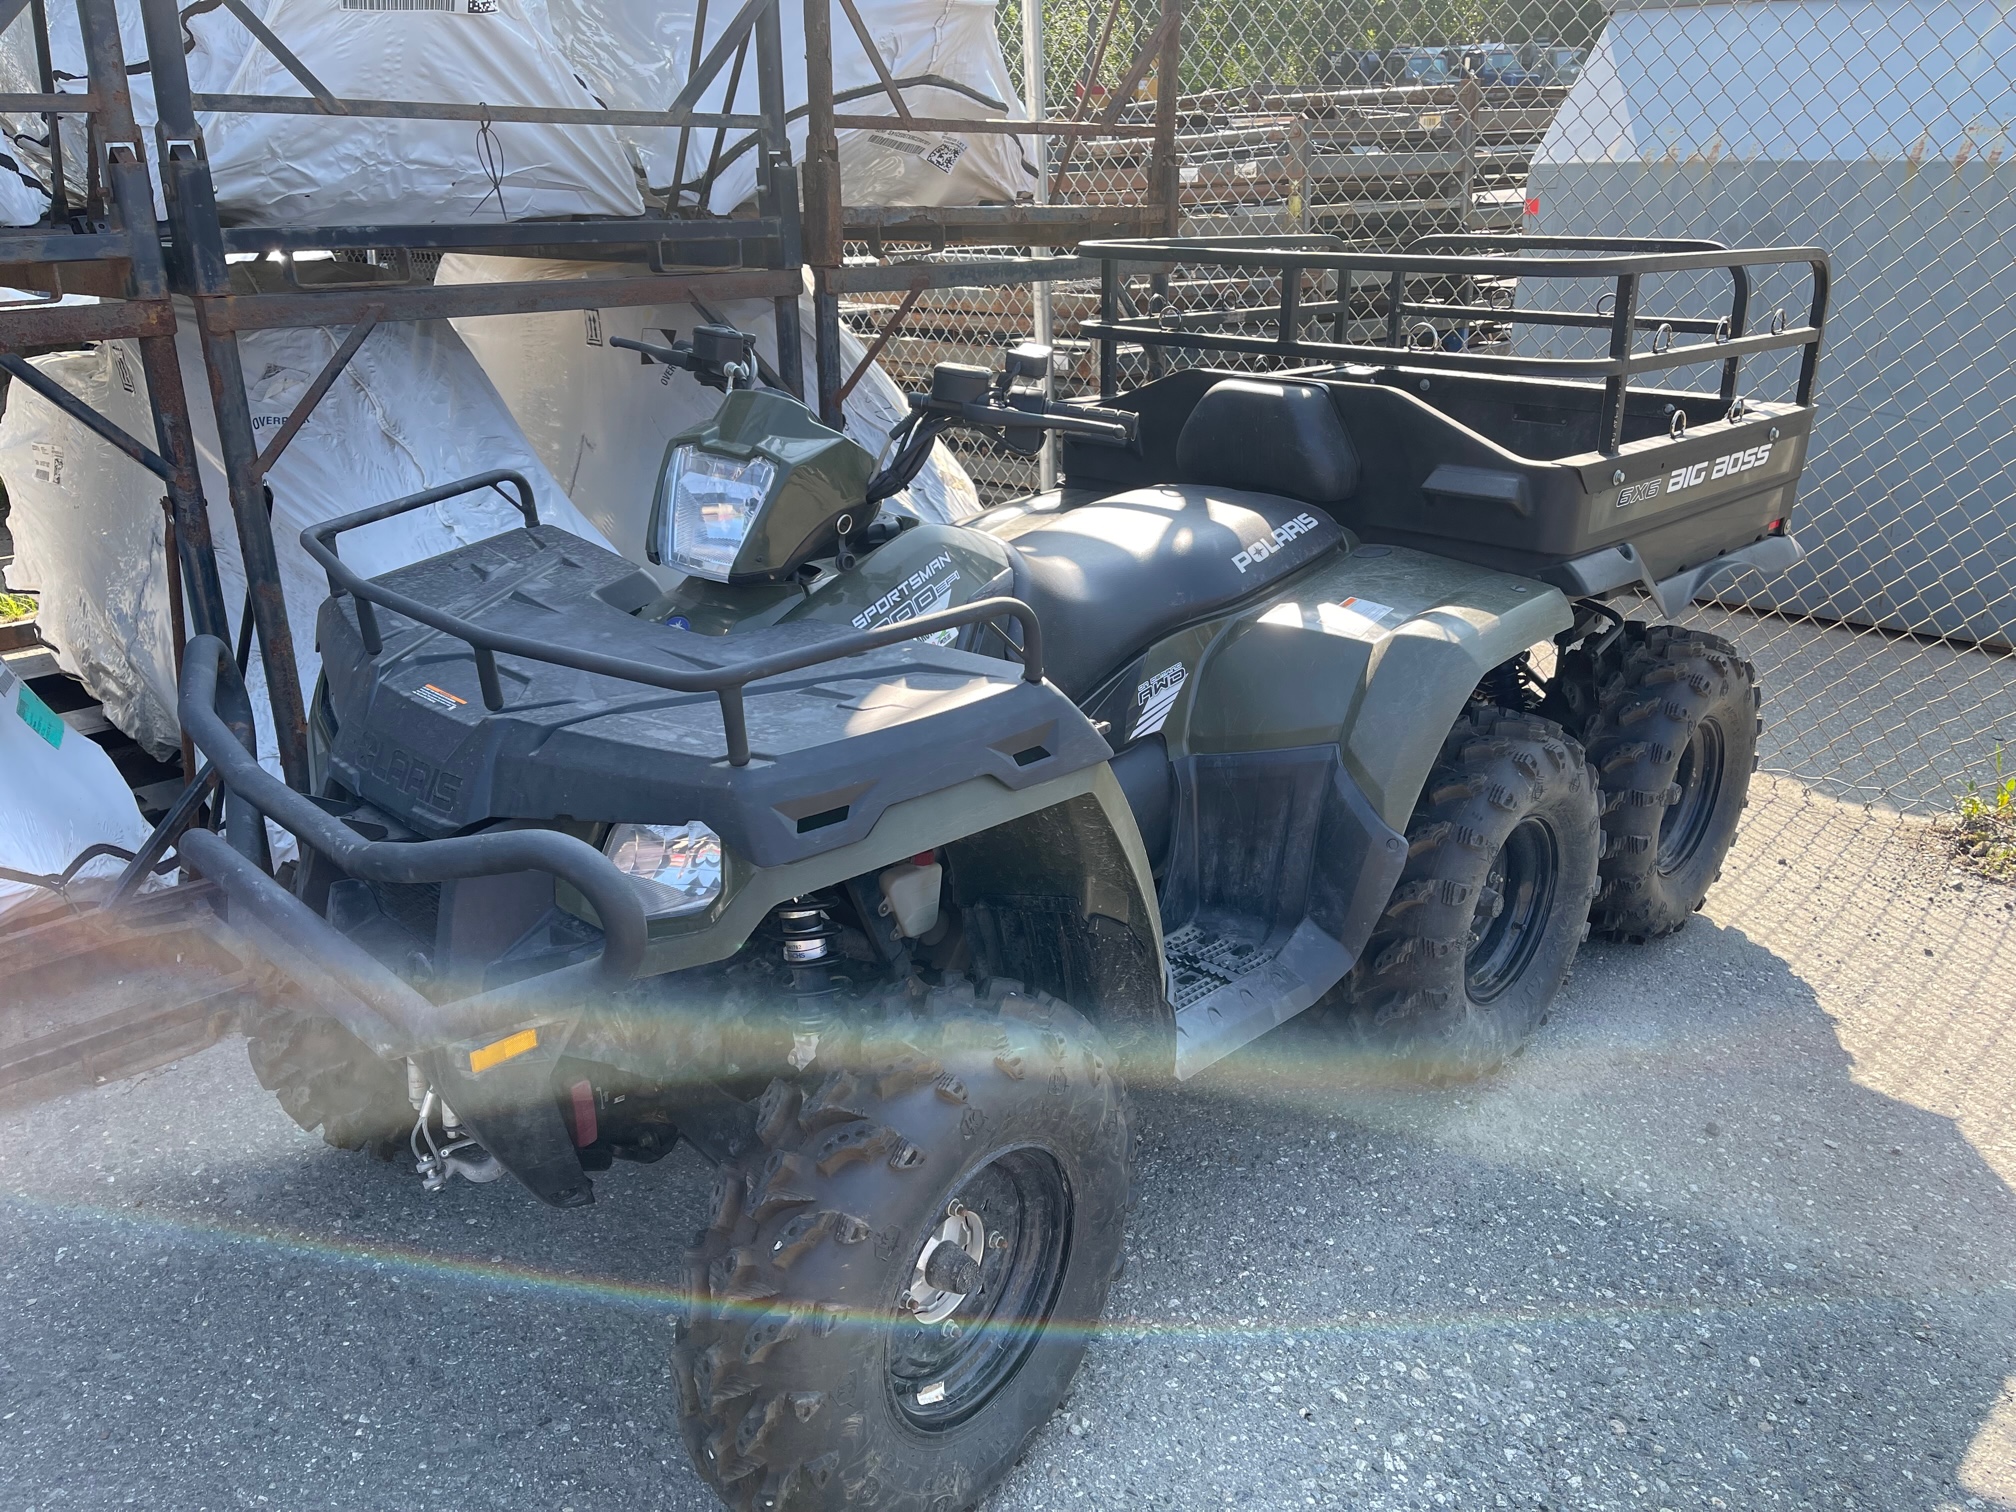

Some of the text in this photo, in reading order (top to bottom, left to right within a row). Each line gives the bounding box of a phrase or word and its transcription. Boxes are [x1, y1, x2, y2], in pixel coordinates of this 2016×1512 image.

[252, 415, 310, 430] OVERP
[1666, 461, 1709, 494] BIG
[1711, 443, 1773, 480] BOSS
[1231, 512, 1319, 574] POLARIS
[851, 551, 952, 629] SPORTSMAN
[1138, 667, 1186, 706] AWD
